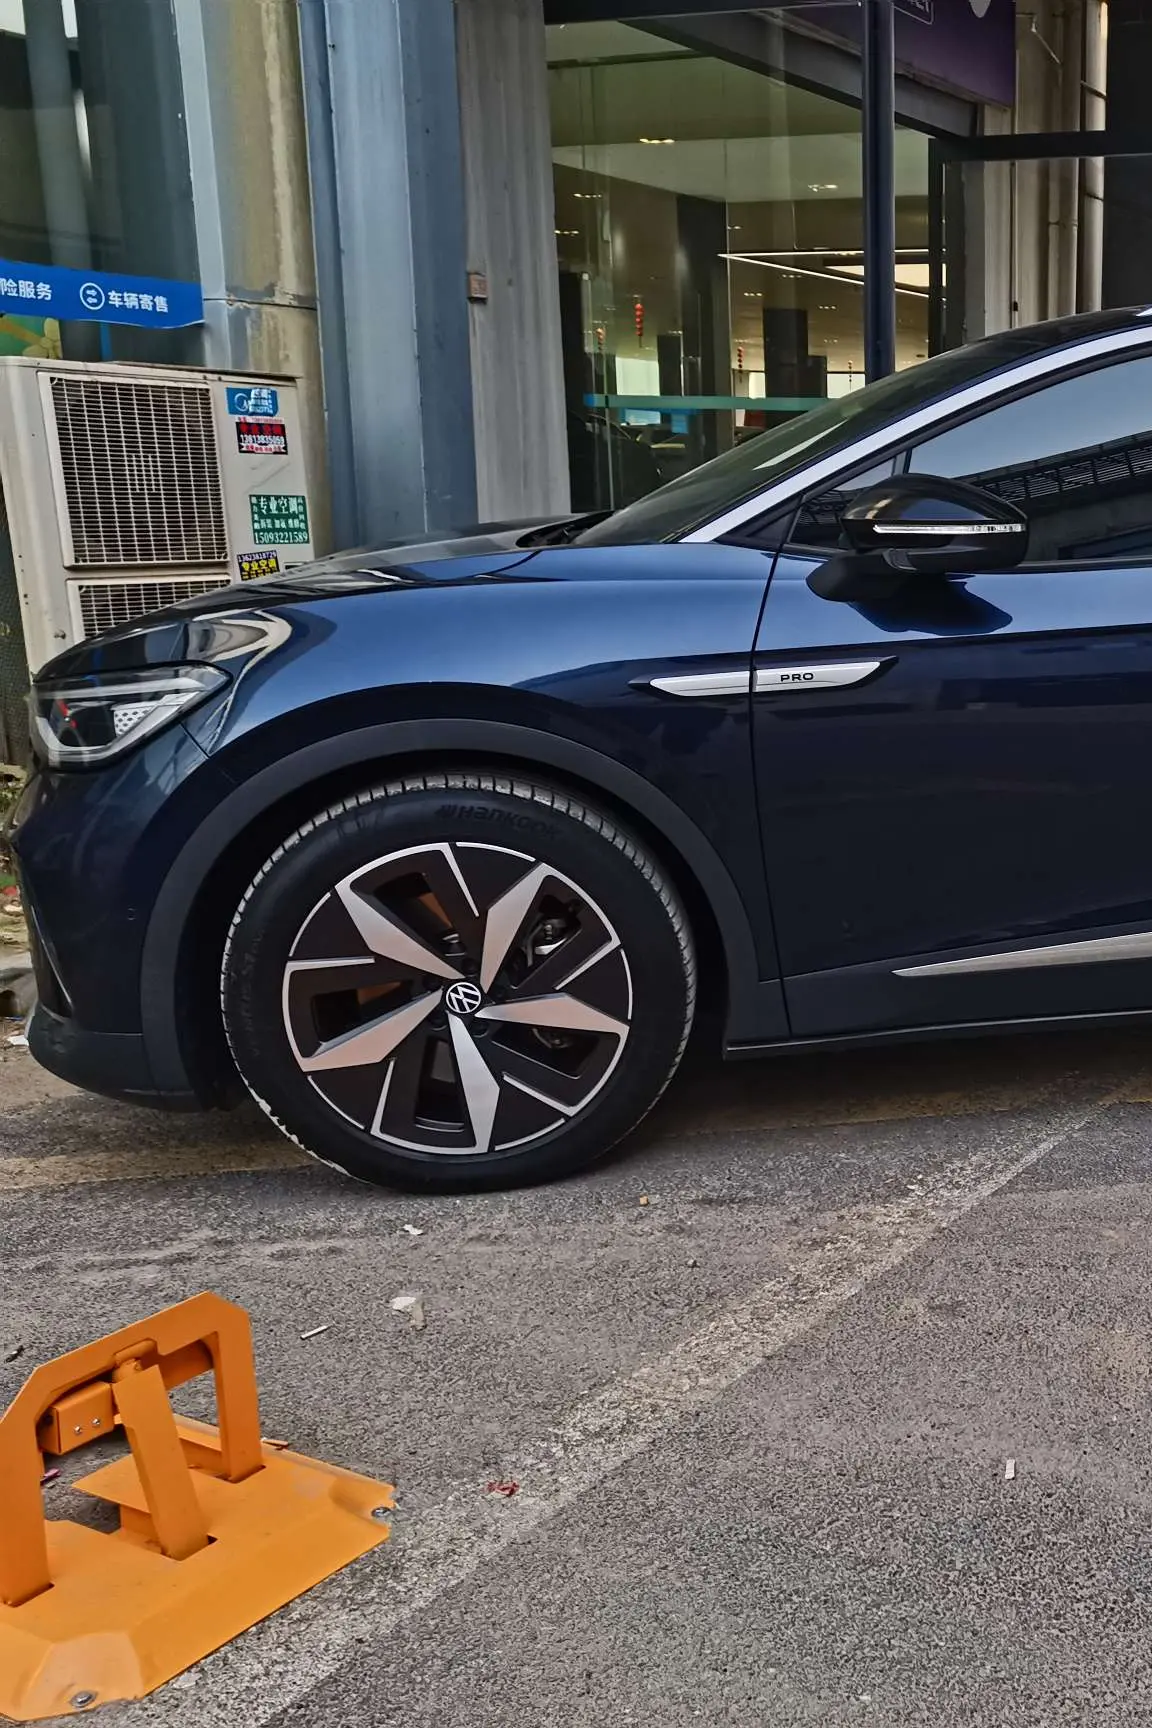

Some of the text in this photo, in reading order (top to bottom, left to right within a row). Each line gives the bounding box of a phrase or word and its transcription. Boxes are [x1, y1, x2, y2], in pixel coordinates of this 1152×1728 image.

[108, 290, 169, 313] 车辆寄售
[780, 672, 814, 682] PRO
